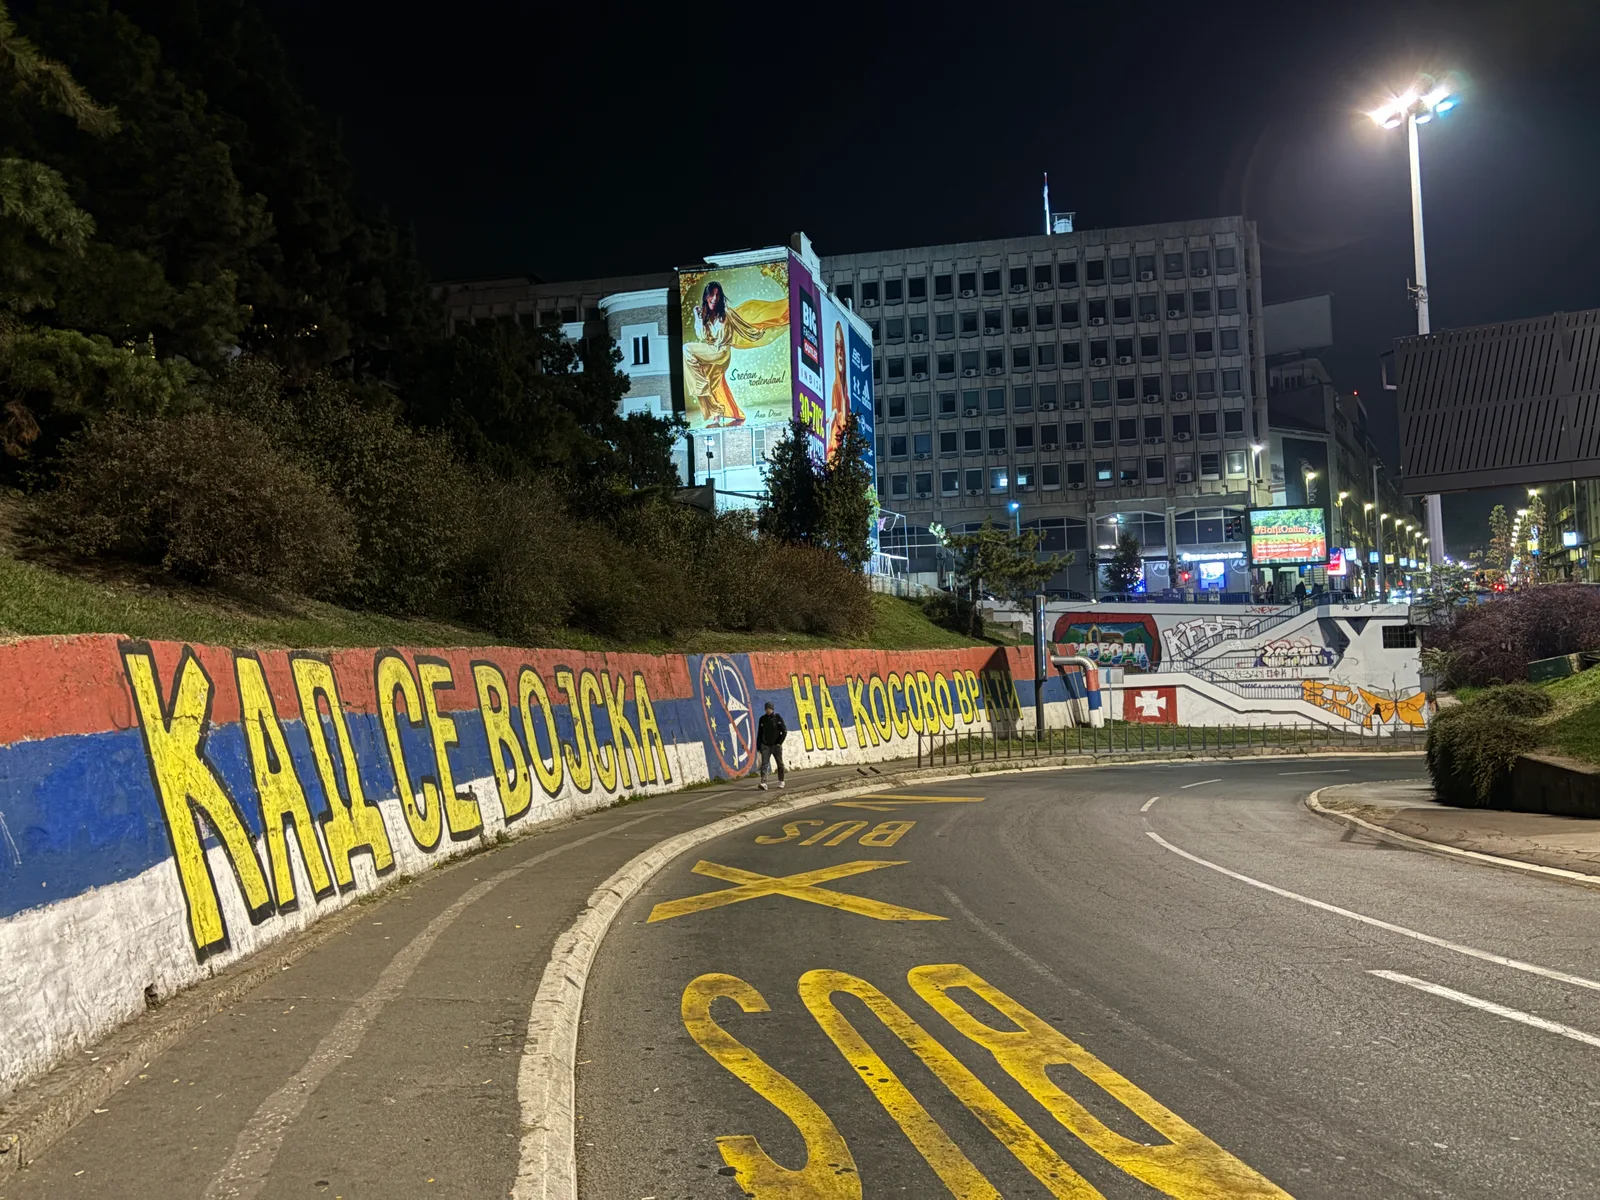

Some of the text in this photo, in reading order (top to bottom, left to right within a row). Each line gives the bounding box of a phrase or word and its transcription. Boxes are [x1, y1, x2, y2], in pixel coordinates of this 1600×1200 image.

[802, 301, 817, 336] BIG
[799, 392, 825, 438] 30-70%
[118, 638, 1025, 964] КАД СЕ ВОЈСКА НА КОСОВО ВРАТИ
[754, 819, 917, 847] BUS
[680, 963, 1298, 1200] BUS
